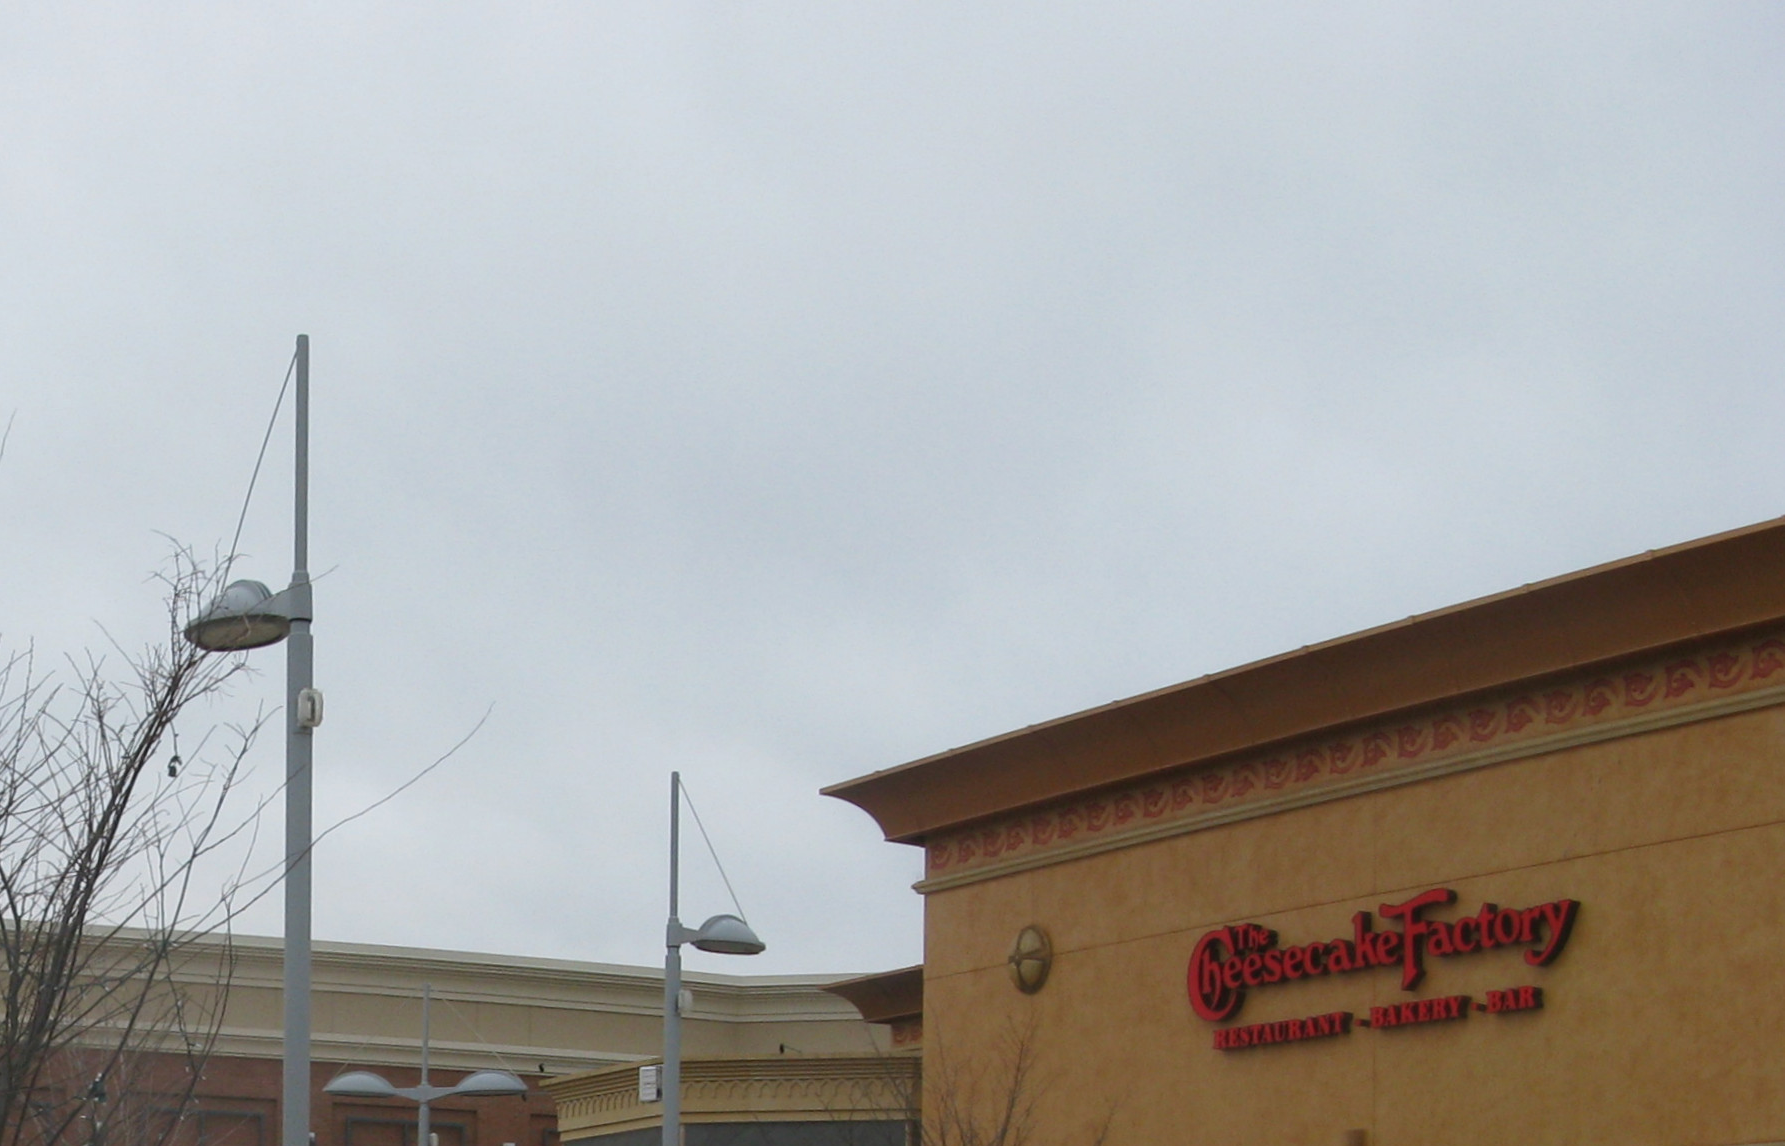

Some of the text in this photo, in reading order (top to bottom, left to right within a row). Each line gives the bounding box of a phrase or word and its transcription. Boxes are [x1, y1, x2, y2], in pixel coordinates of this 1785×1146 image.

[1188, 888, 1579, 1022] Cheesecake Factory
[1233, 923, 1274, 953] The
[1213, 986, 1543, 1050] RESTAURANT BAKERY BAR
